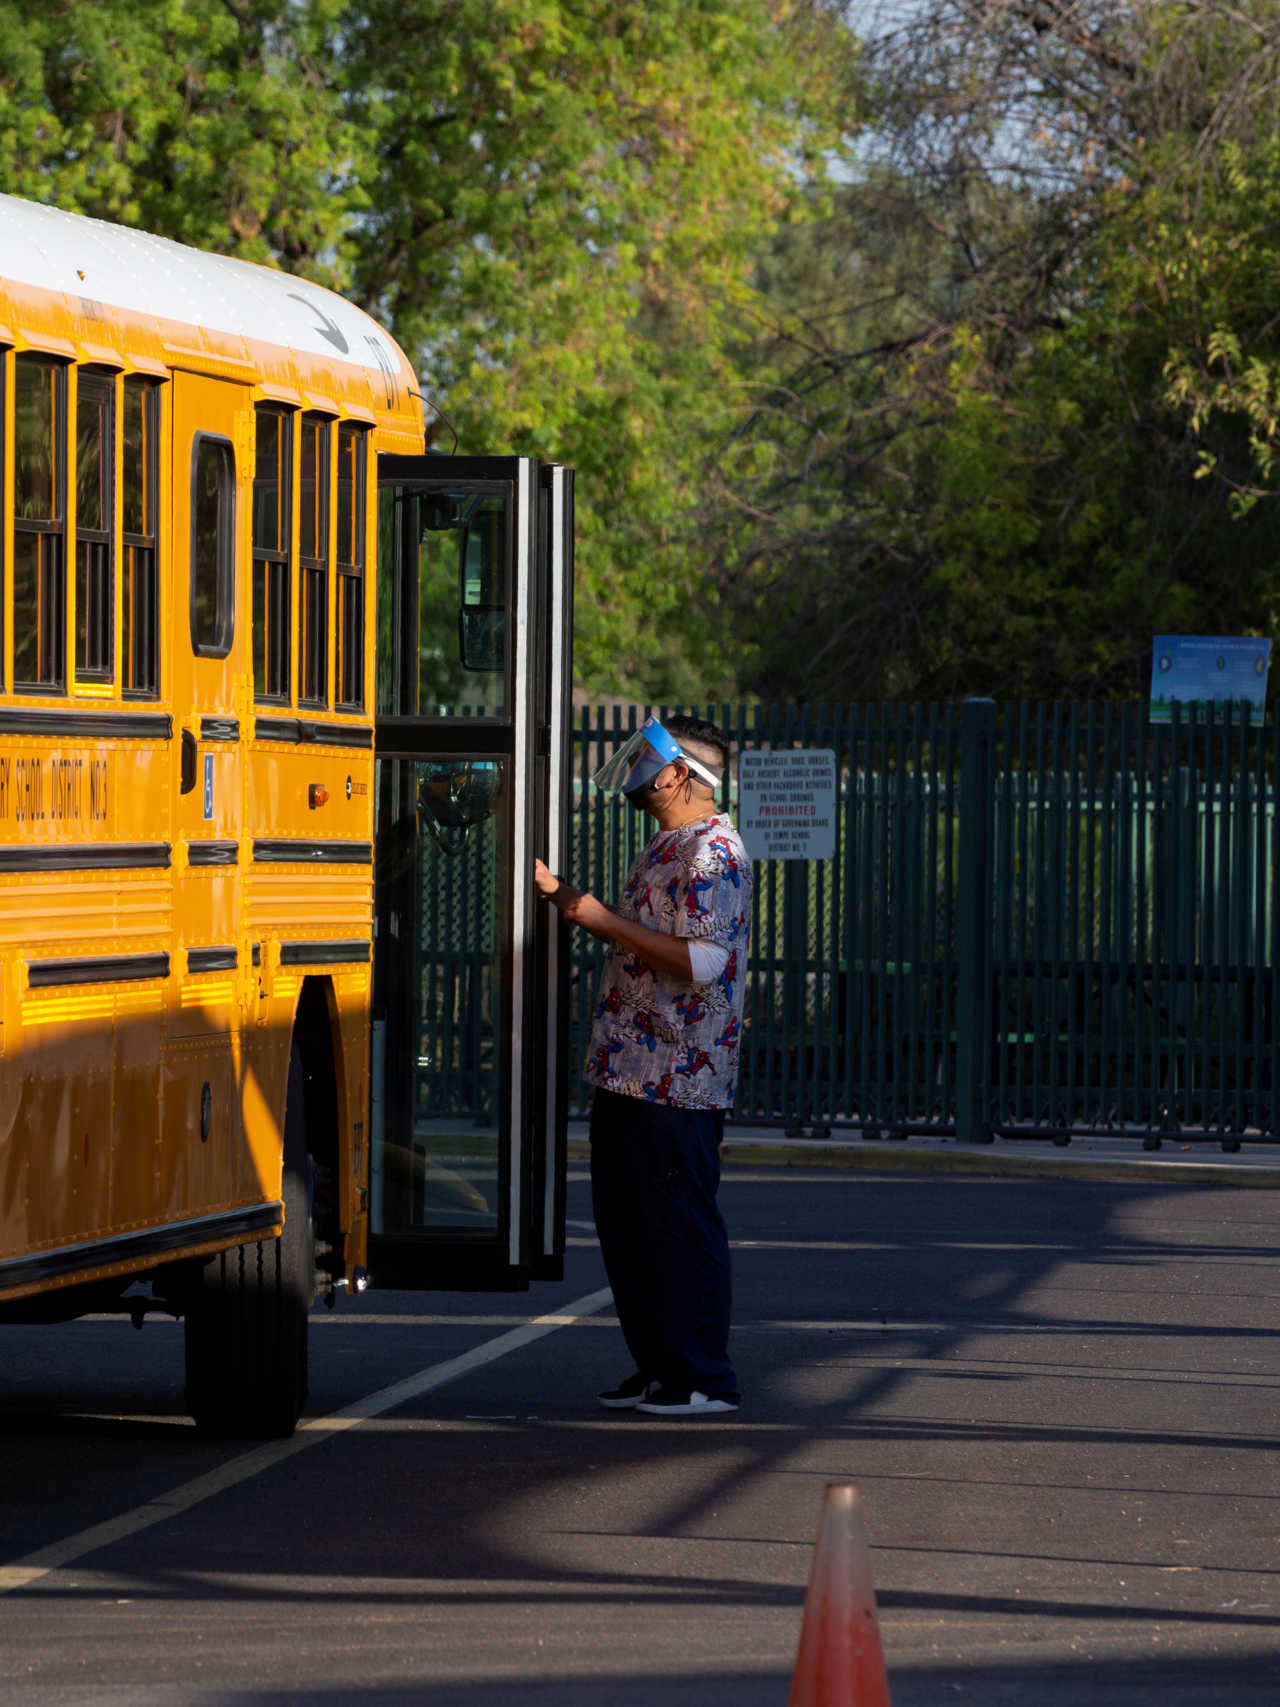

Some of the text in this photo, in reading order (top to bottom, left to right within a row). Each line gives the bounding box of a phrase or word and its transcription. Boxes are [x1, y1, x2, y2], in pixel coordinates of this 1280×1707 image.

[15, 758, 45, 822] SCHOOL
[51, 758, 83, 821] DISTRICT
[758, 804, 817, 817] PROHIBITED
